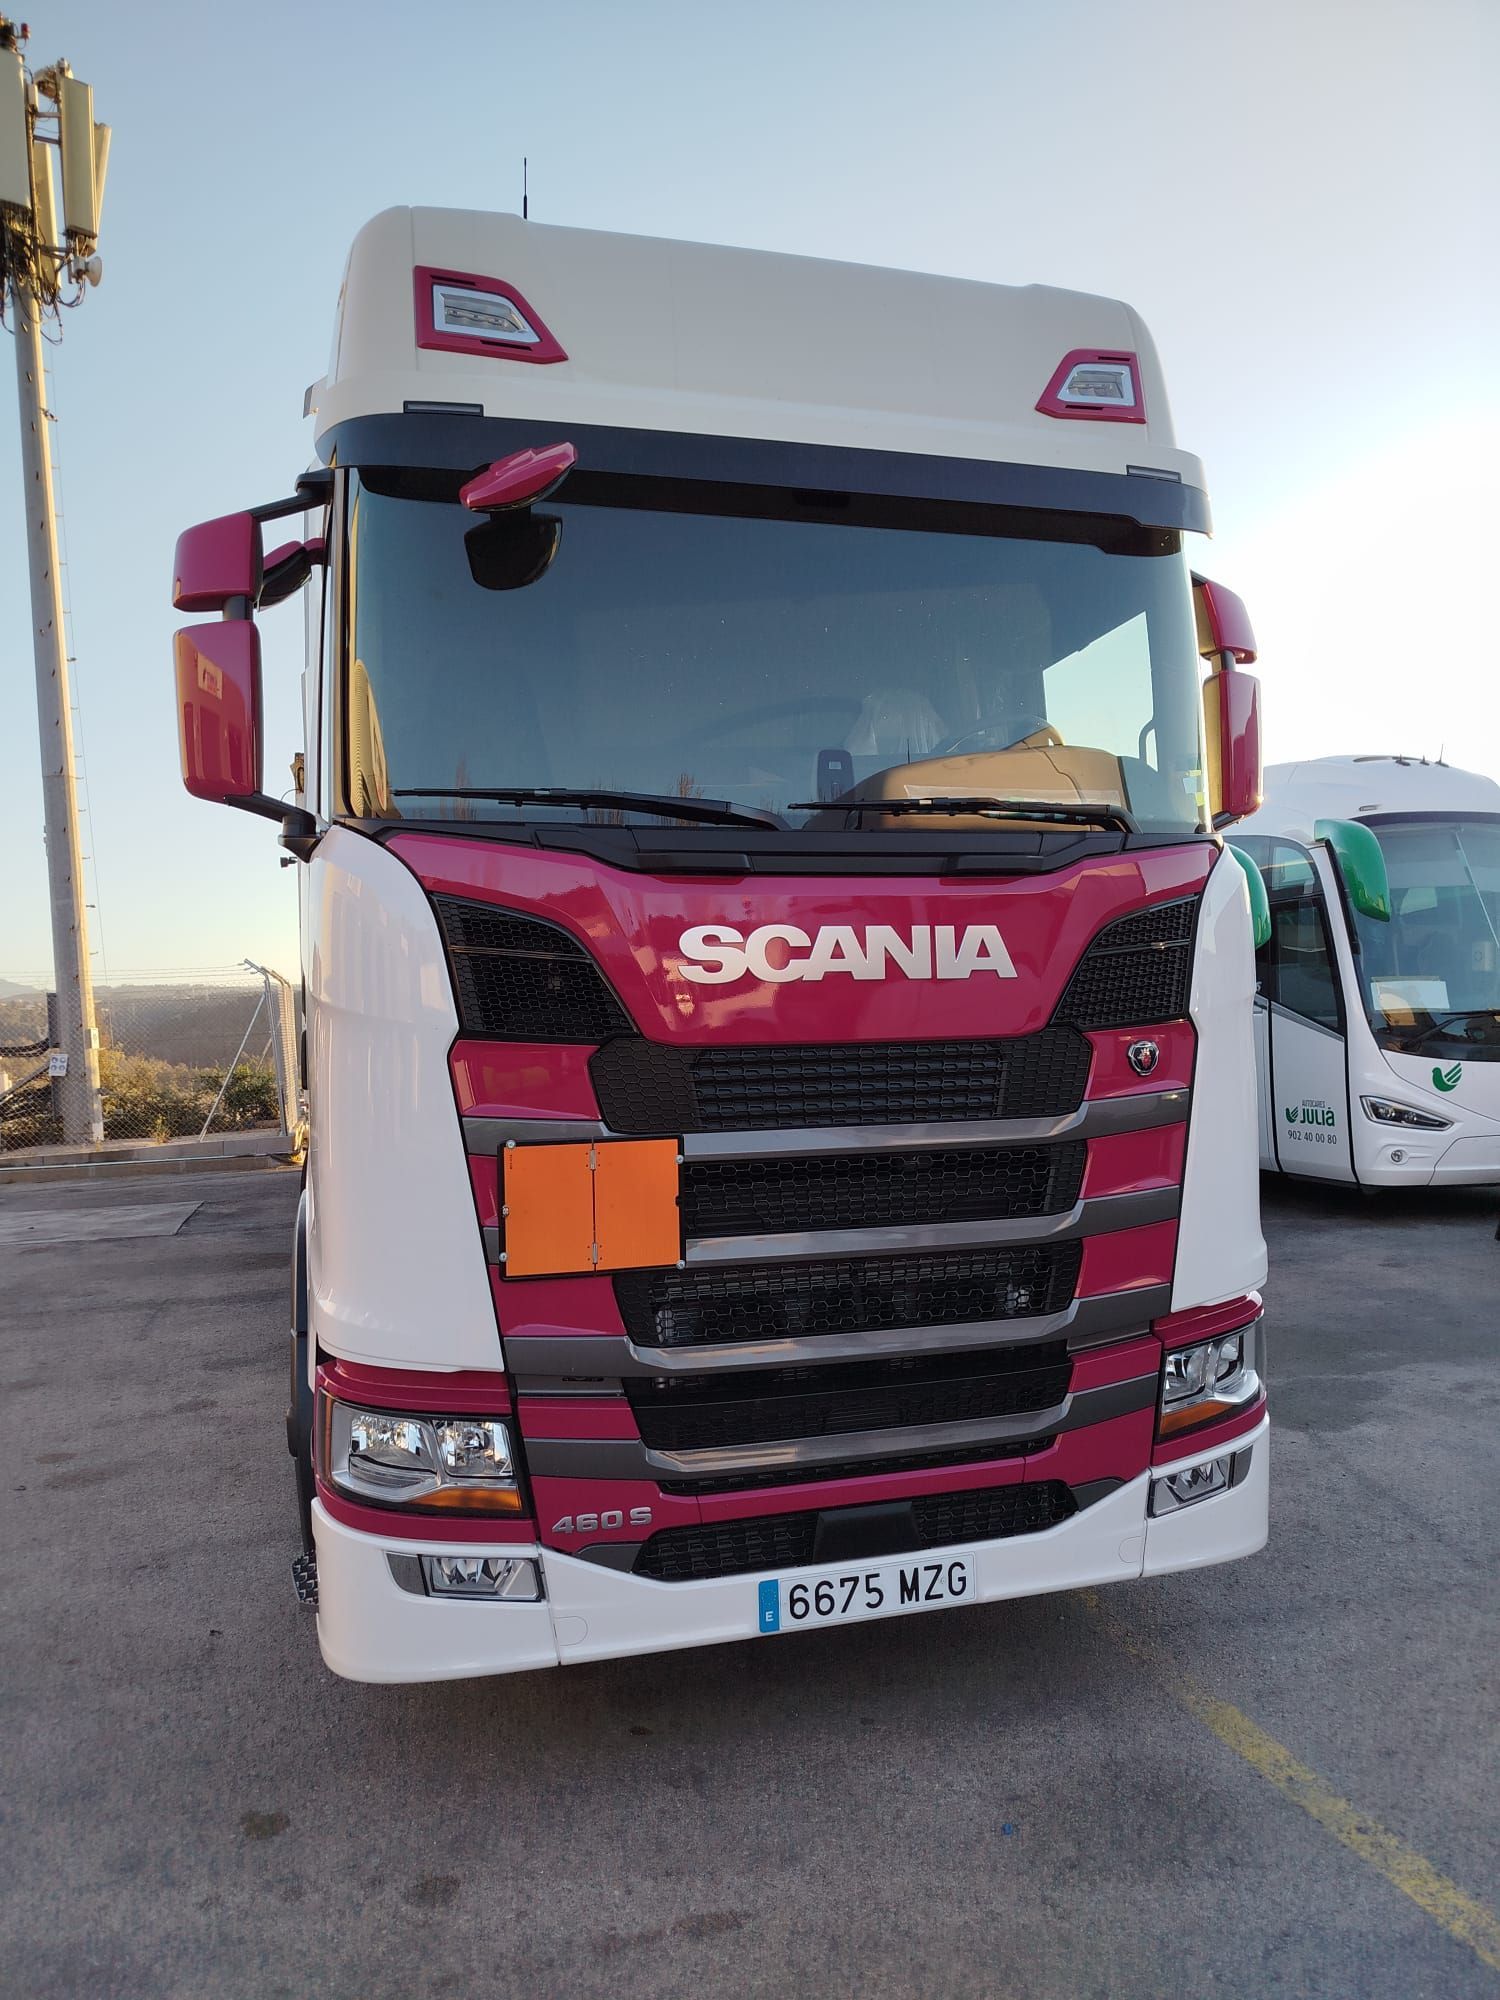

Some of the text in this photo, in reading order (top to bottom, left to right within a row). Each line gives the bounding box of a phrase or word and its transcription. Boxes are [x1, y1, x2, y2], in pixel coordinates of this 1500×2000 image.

[678, 924, 1018, 984] SCANIA
[1288, 1130, 1337, 1144] 902 40 00 80
[552, 1506, 653, 1533] 460 S
[789, 1561, 967, 1620] 6675 MZG
[765, 1611, 774, 1622] E
